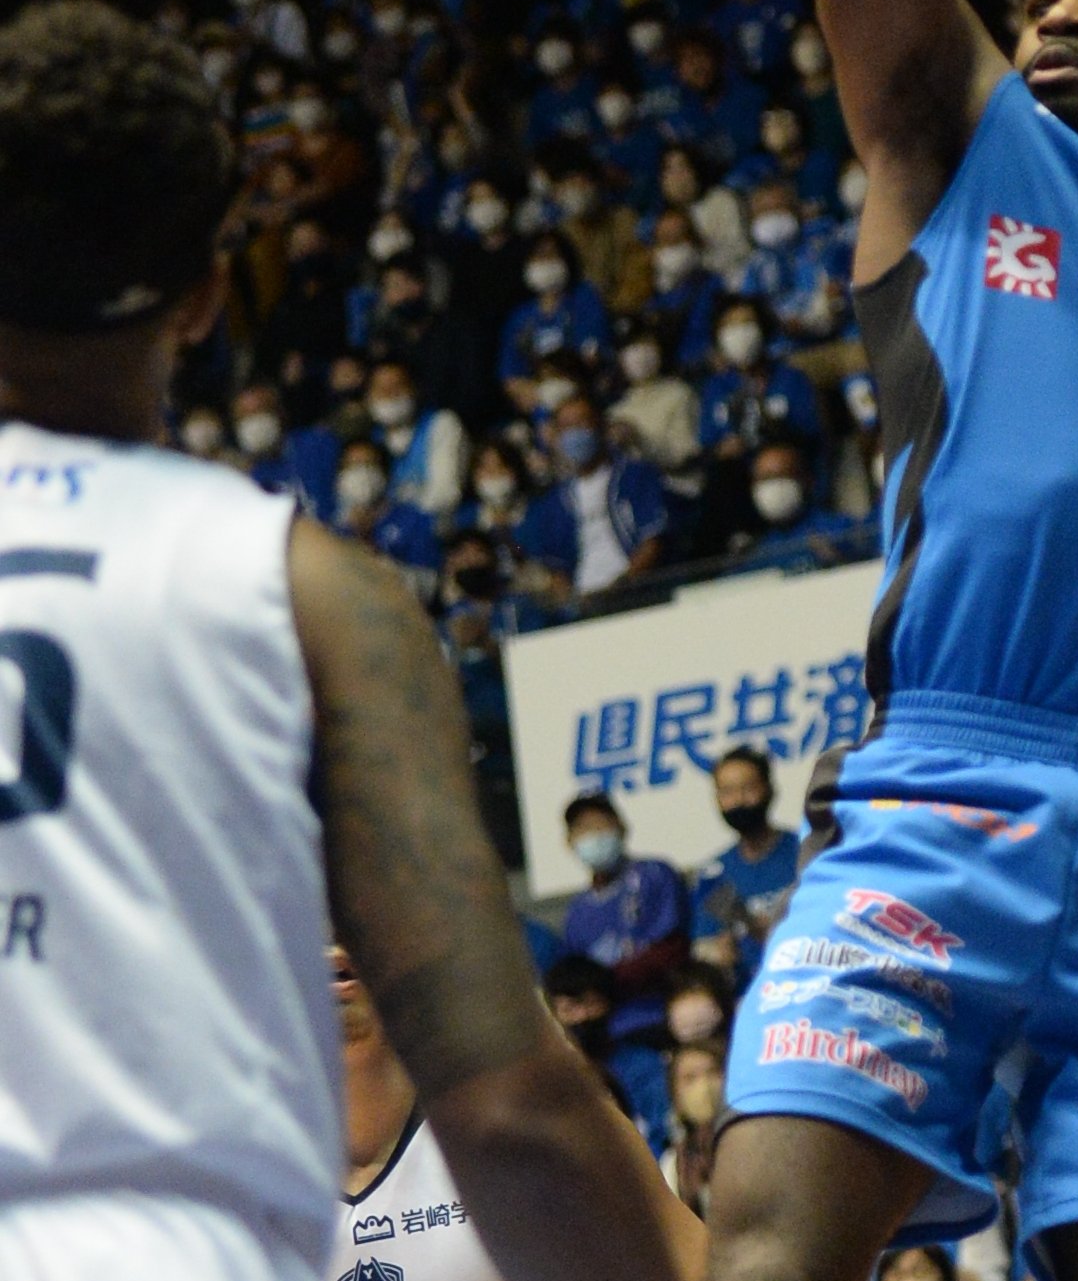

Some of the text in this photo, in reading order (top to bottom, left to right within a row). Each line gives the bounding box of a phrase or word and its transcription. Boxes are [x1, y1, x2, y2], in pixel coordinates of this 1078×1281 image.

[573, 654, 870, 794] 県民共済
[845, 888, 966, 962] TSK
